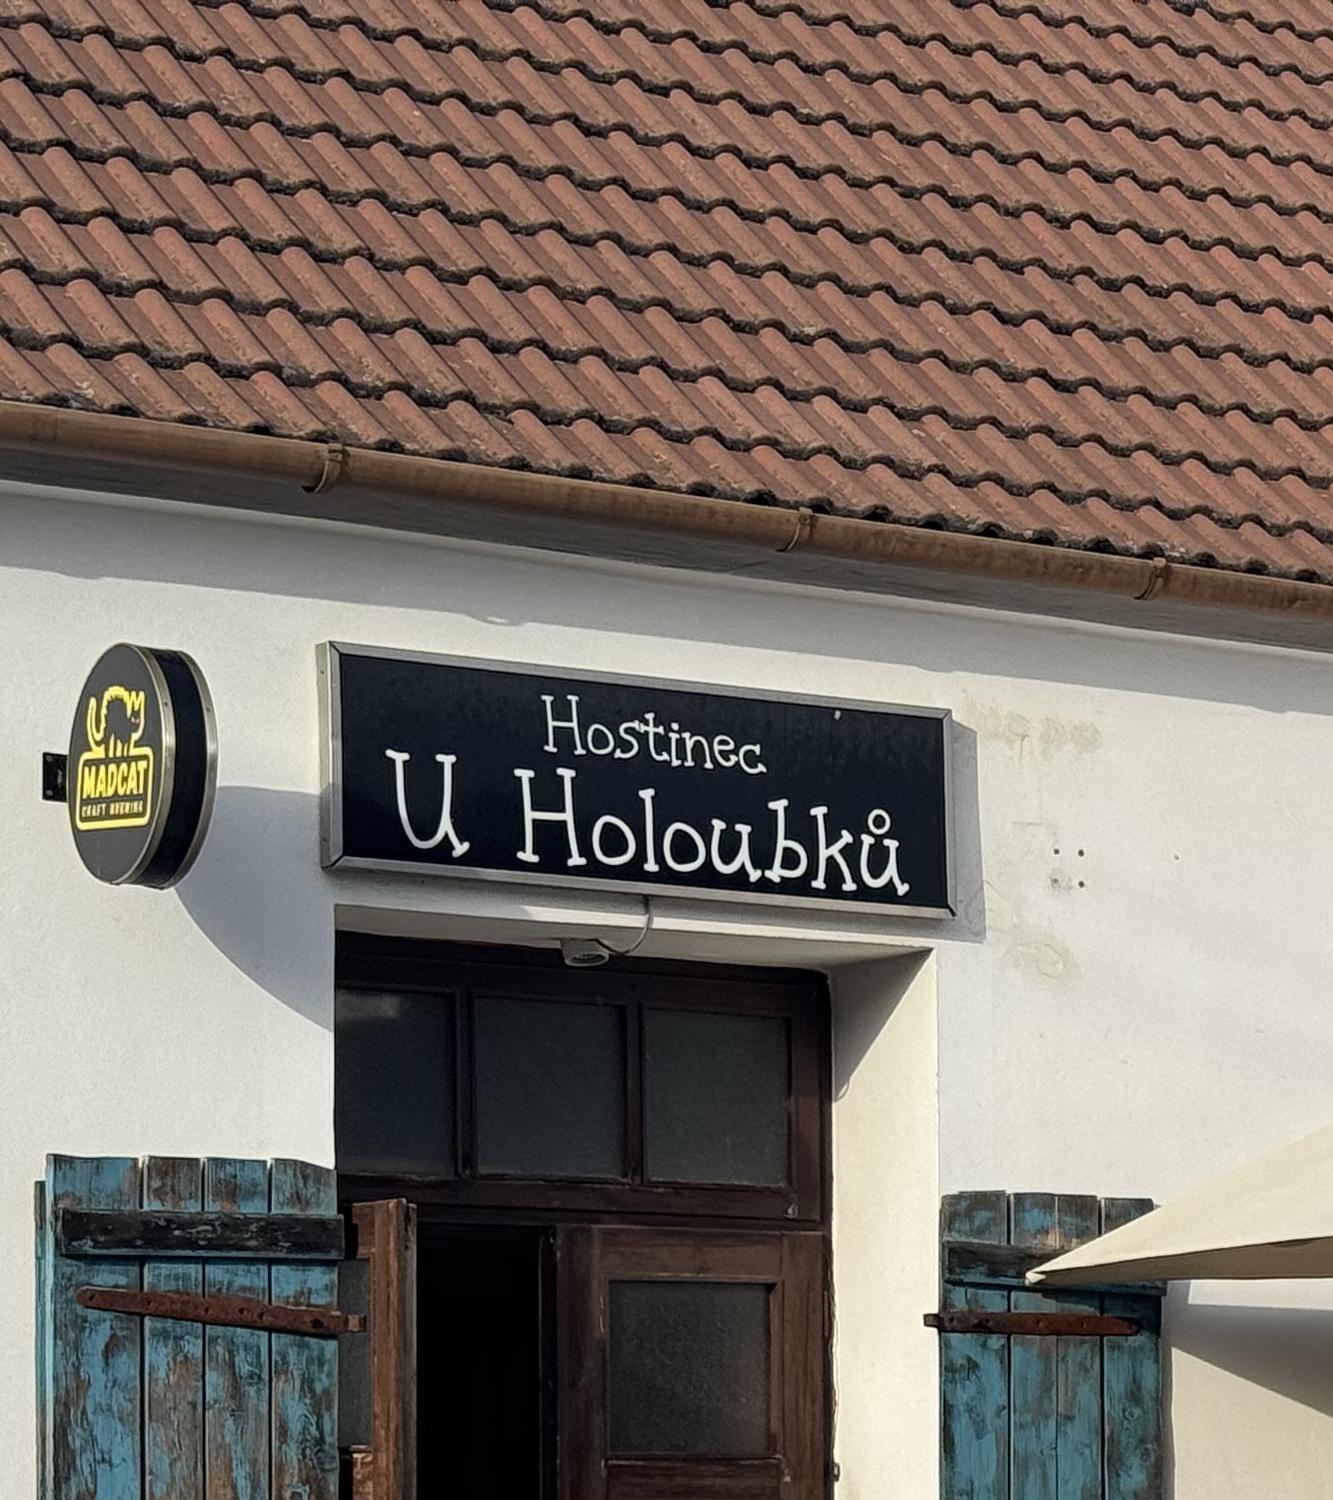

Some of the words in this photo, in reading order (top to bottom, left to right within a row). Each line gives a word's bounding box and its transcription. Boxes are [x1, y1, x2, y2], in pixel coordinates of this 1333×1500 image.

[541, 695, 768, 775] Hostinec
[82, 760, 148, 799] MADCAT
[386, 749, 470, 858] U
[515, 766, 911, 897] Holoubků
